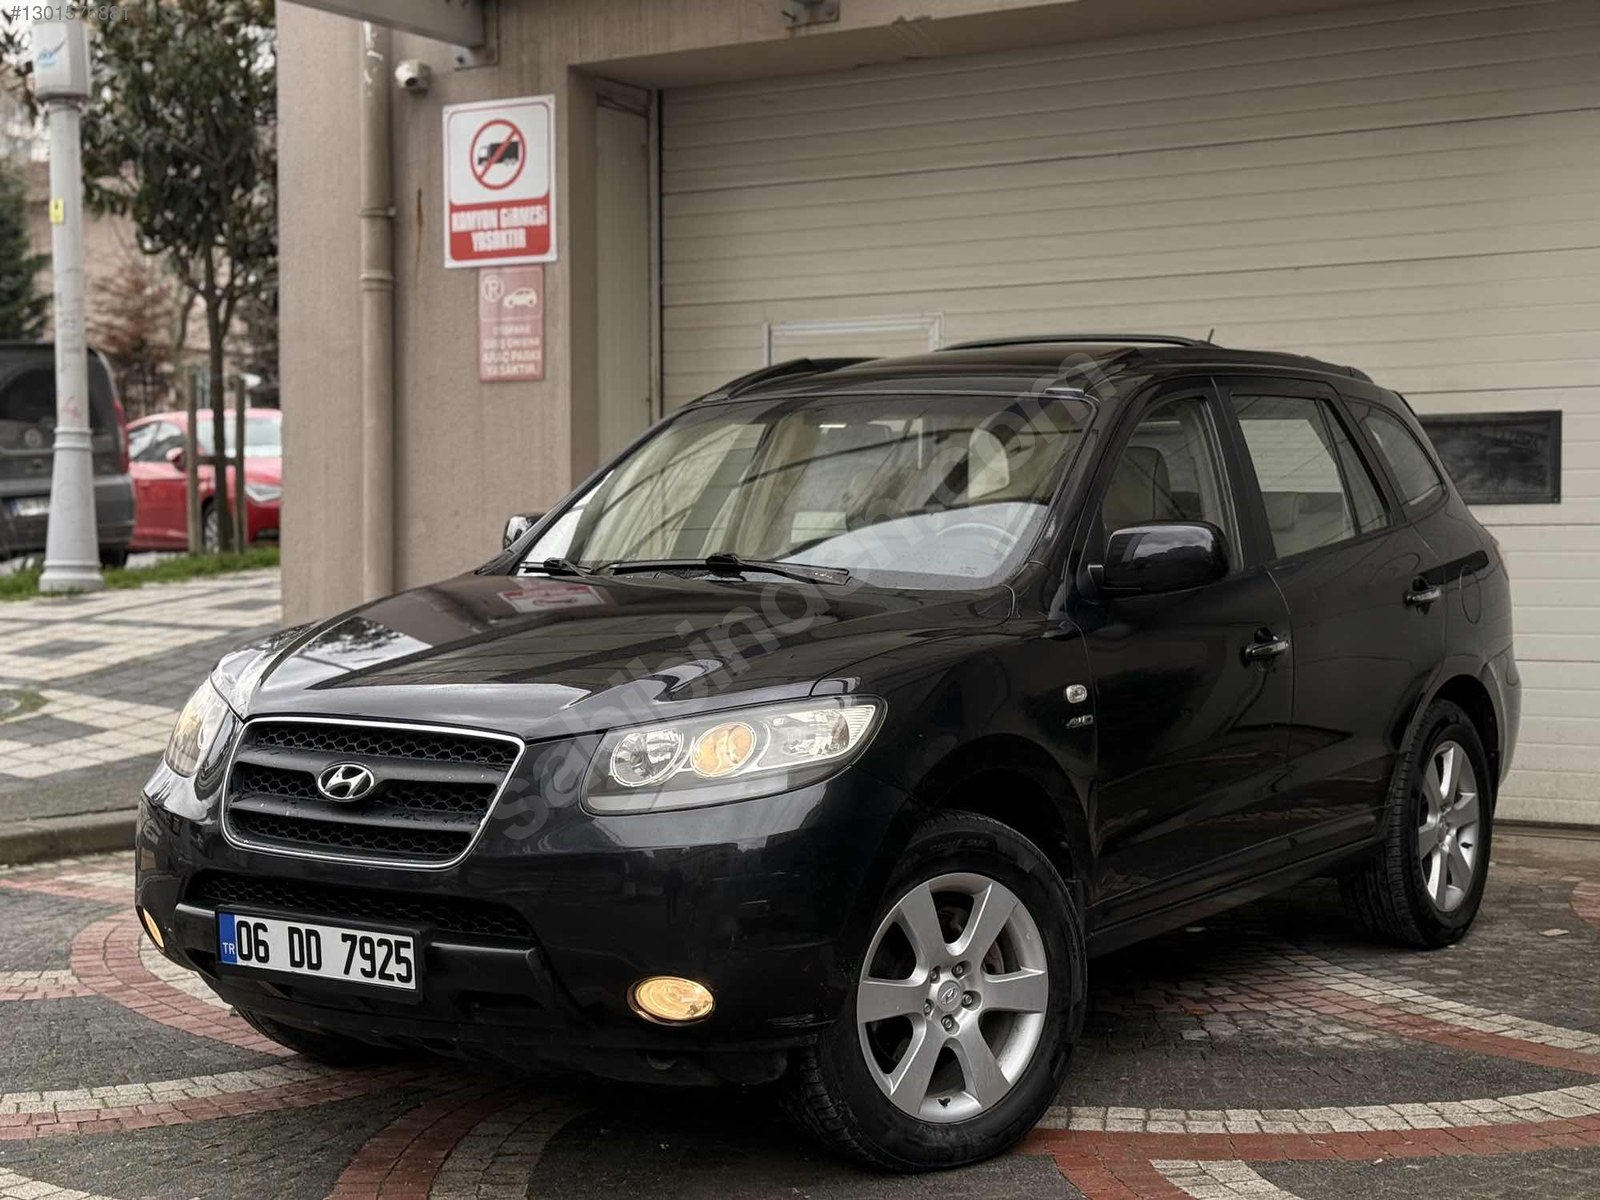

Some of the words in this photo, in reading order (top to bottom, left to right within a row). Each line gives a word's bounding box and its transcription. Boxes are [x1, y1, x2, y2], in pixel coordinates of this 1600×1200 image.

[222, 942, 236, 955] TR
[236, 920, 270, 964] 06
[287, 926, 323, 971] DD
[341, 933, 413, 983] 7925
